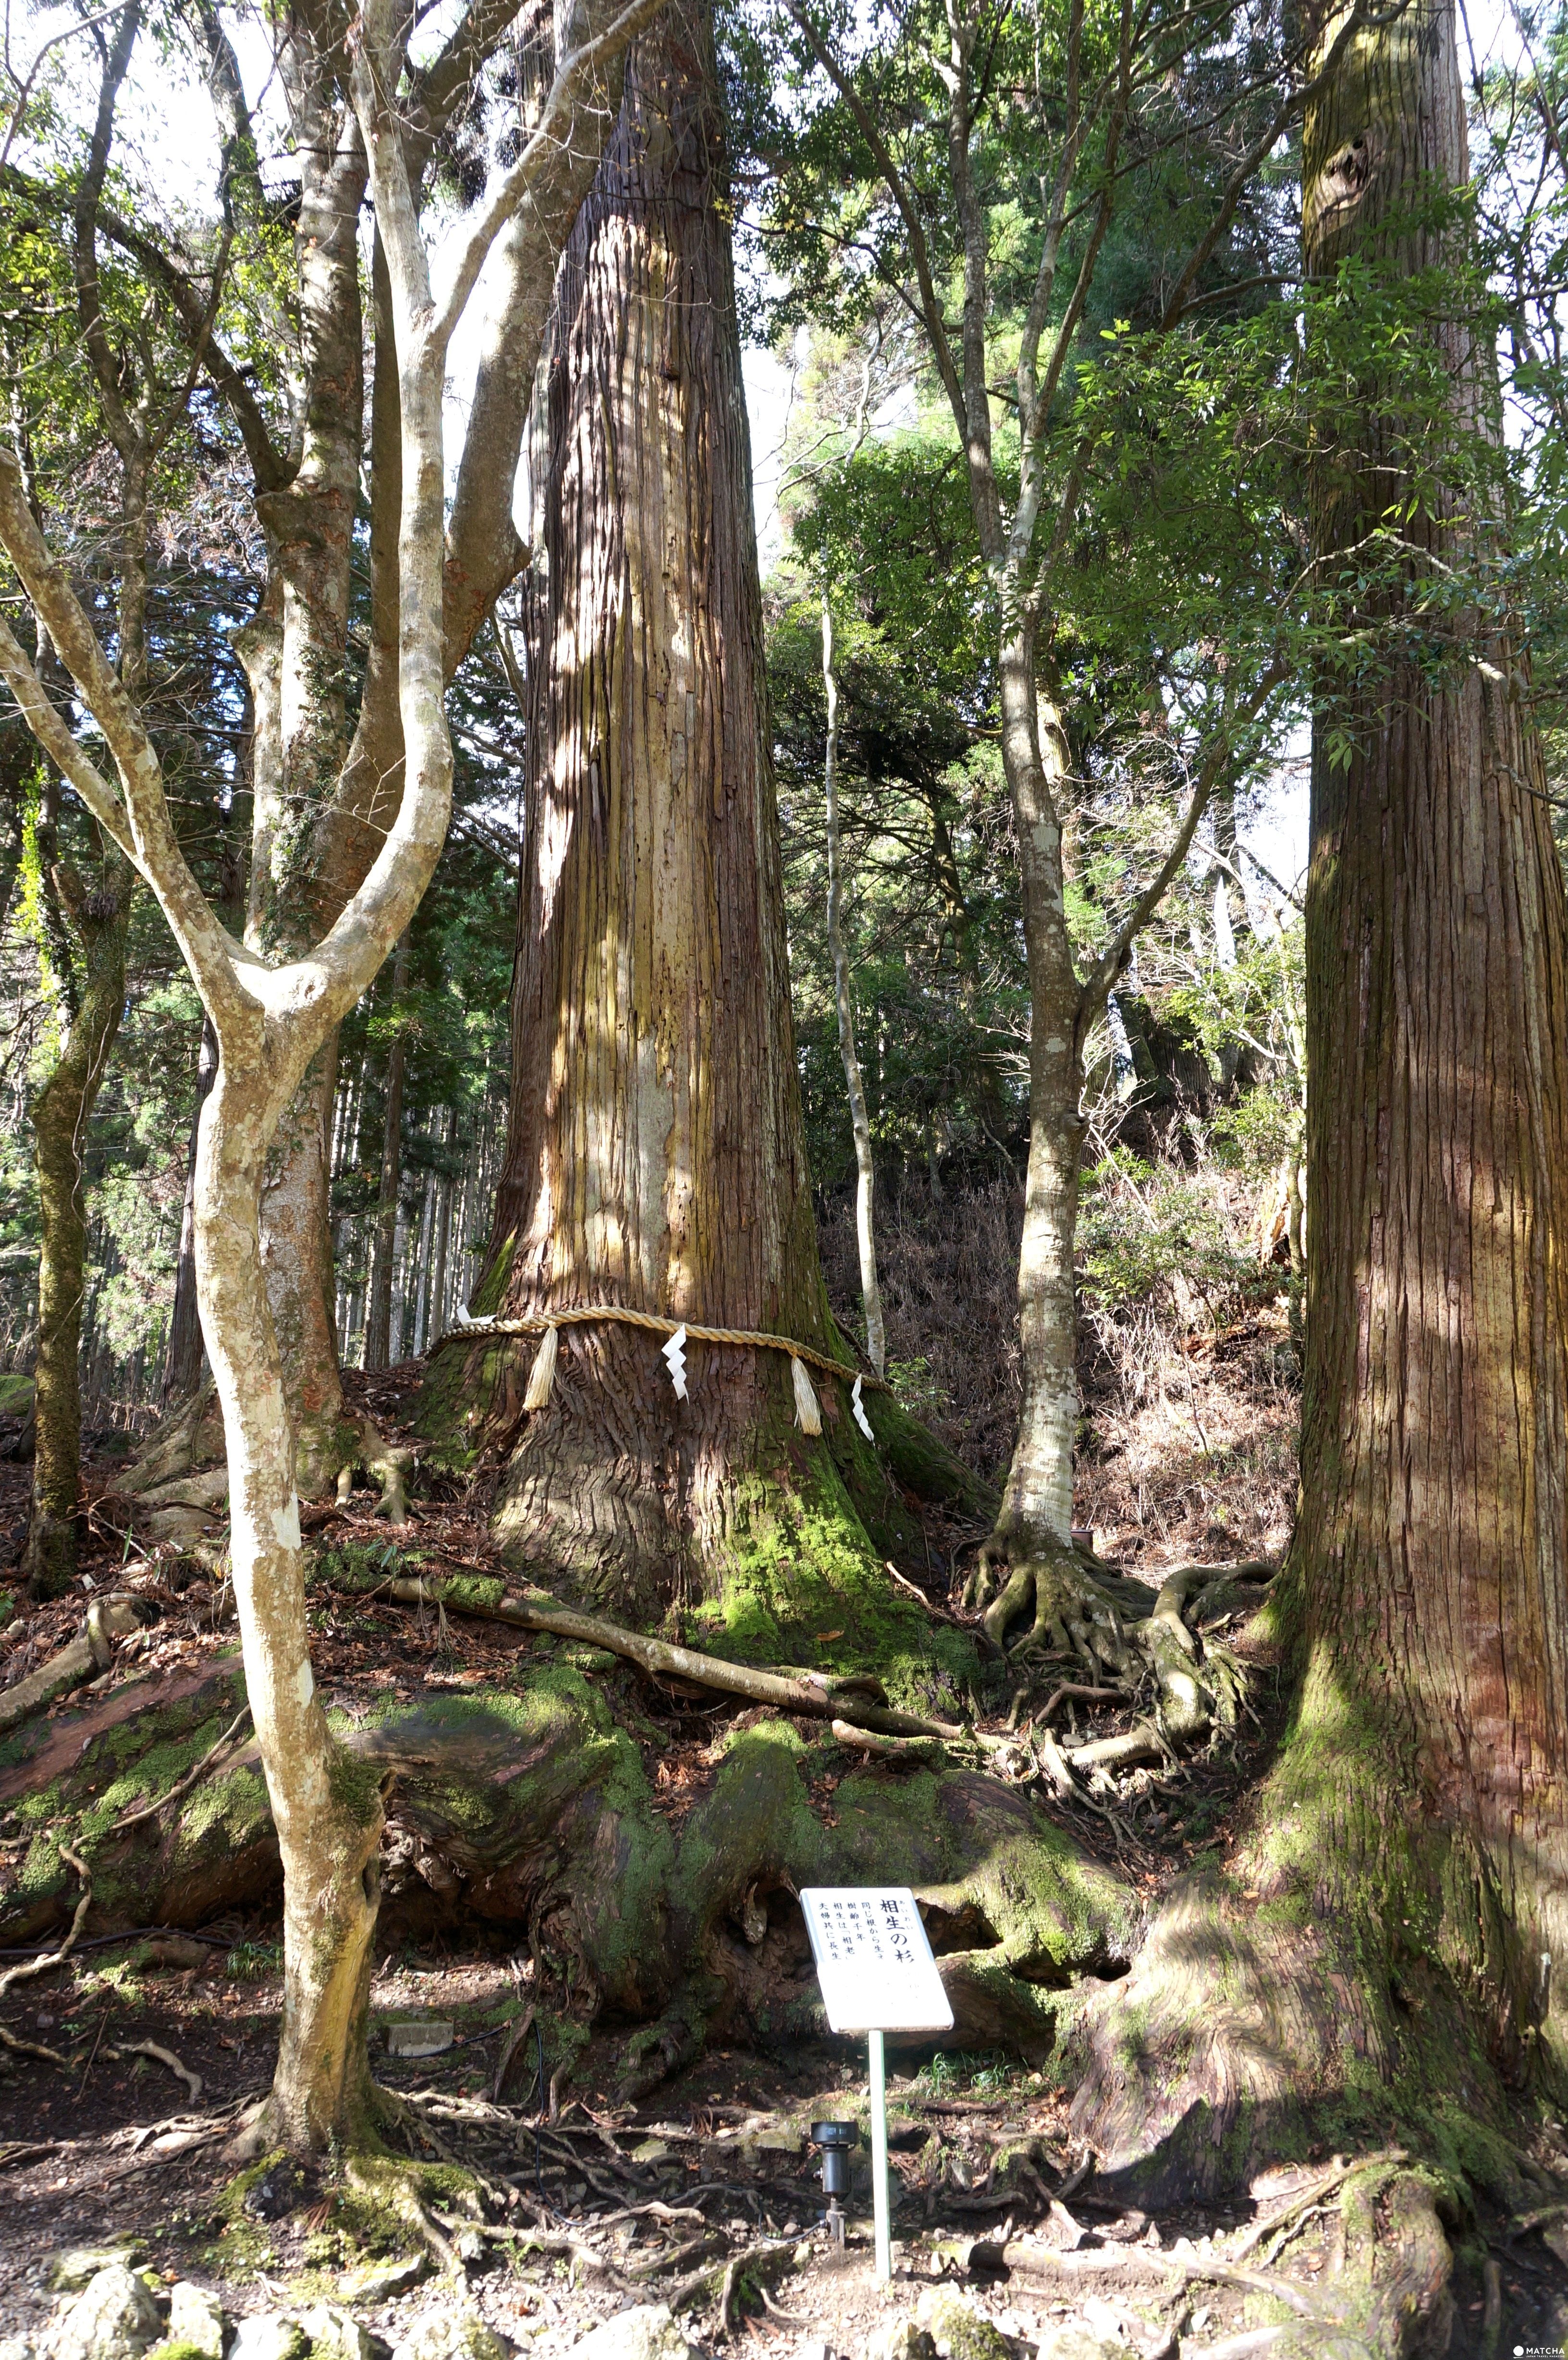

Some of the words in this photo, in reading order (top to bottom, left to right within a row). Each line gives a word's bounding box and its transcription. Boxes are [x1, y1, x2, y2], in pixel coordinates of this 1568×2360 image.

[819, 1903, 842, 1960] 夫婦共に長生
[847, 1902, 865, 1942] 樹齢千年
[880, 1899, 915, 1963] 相生の杉
